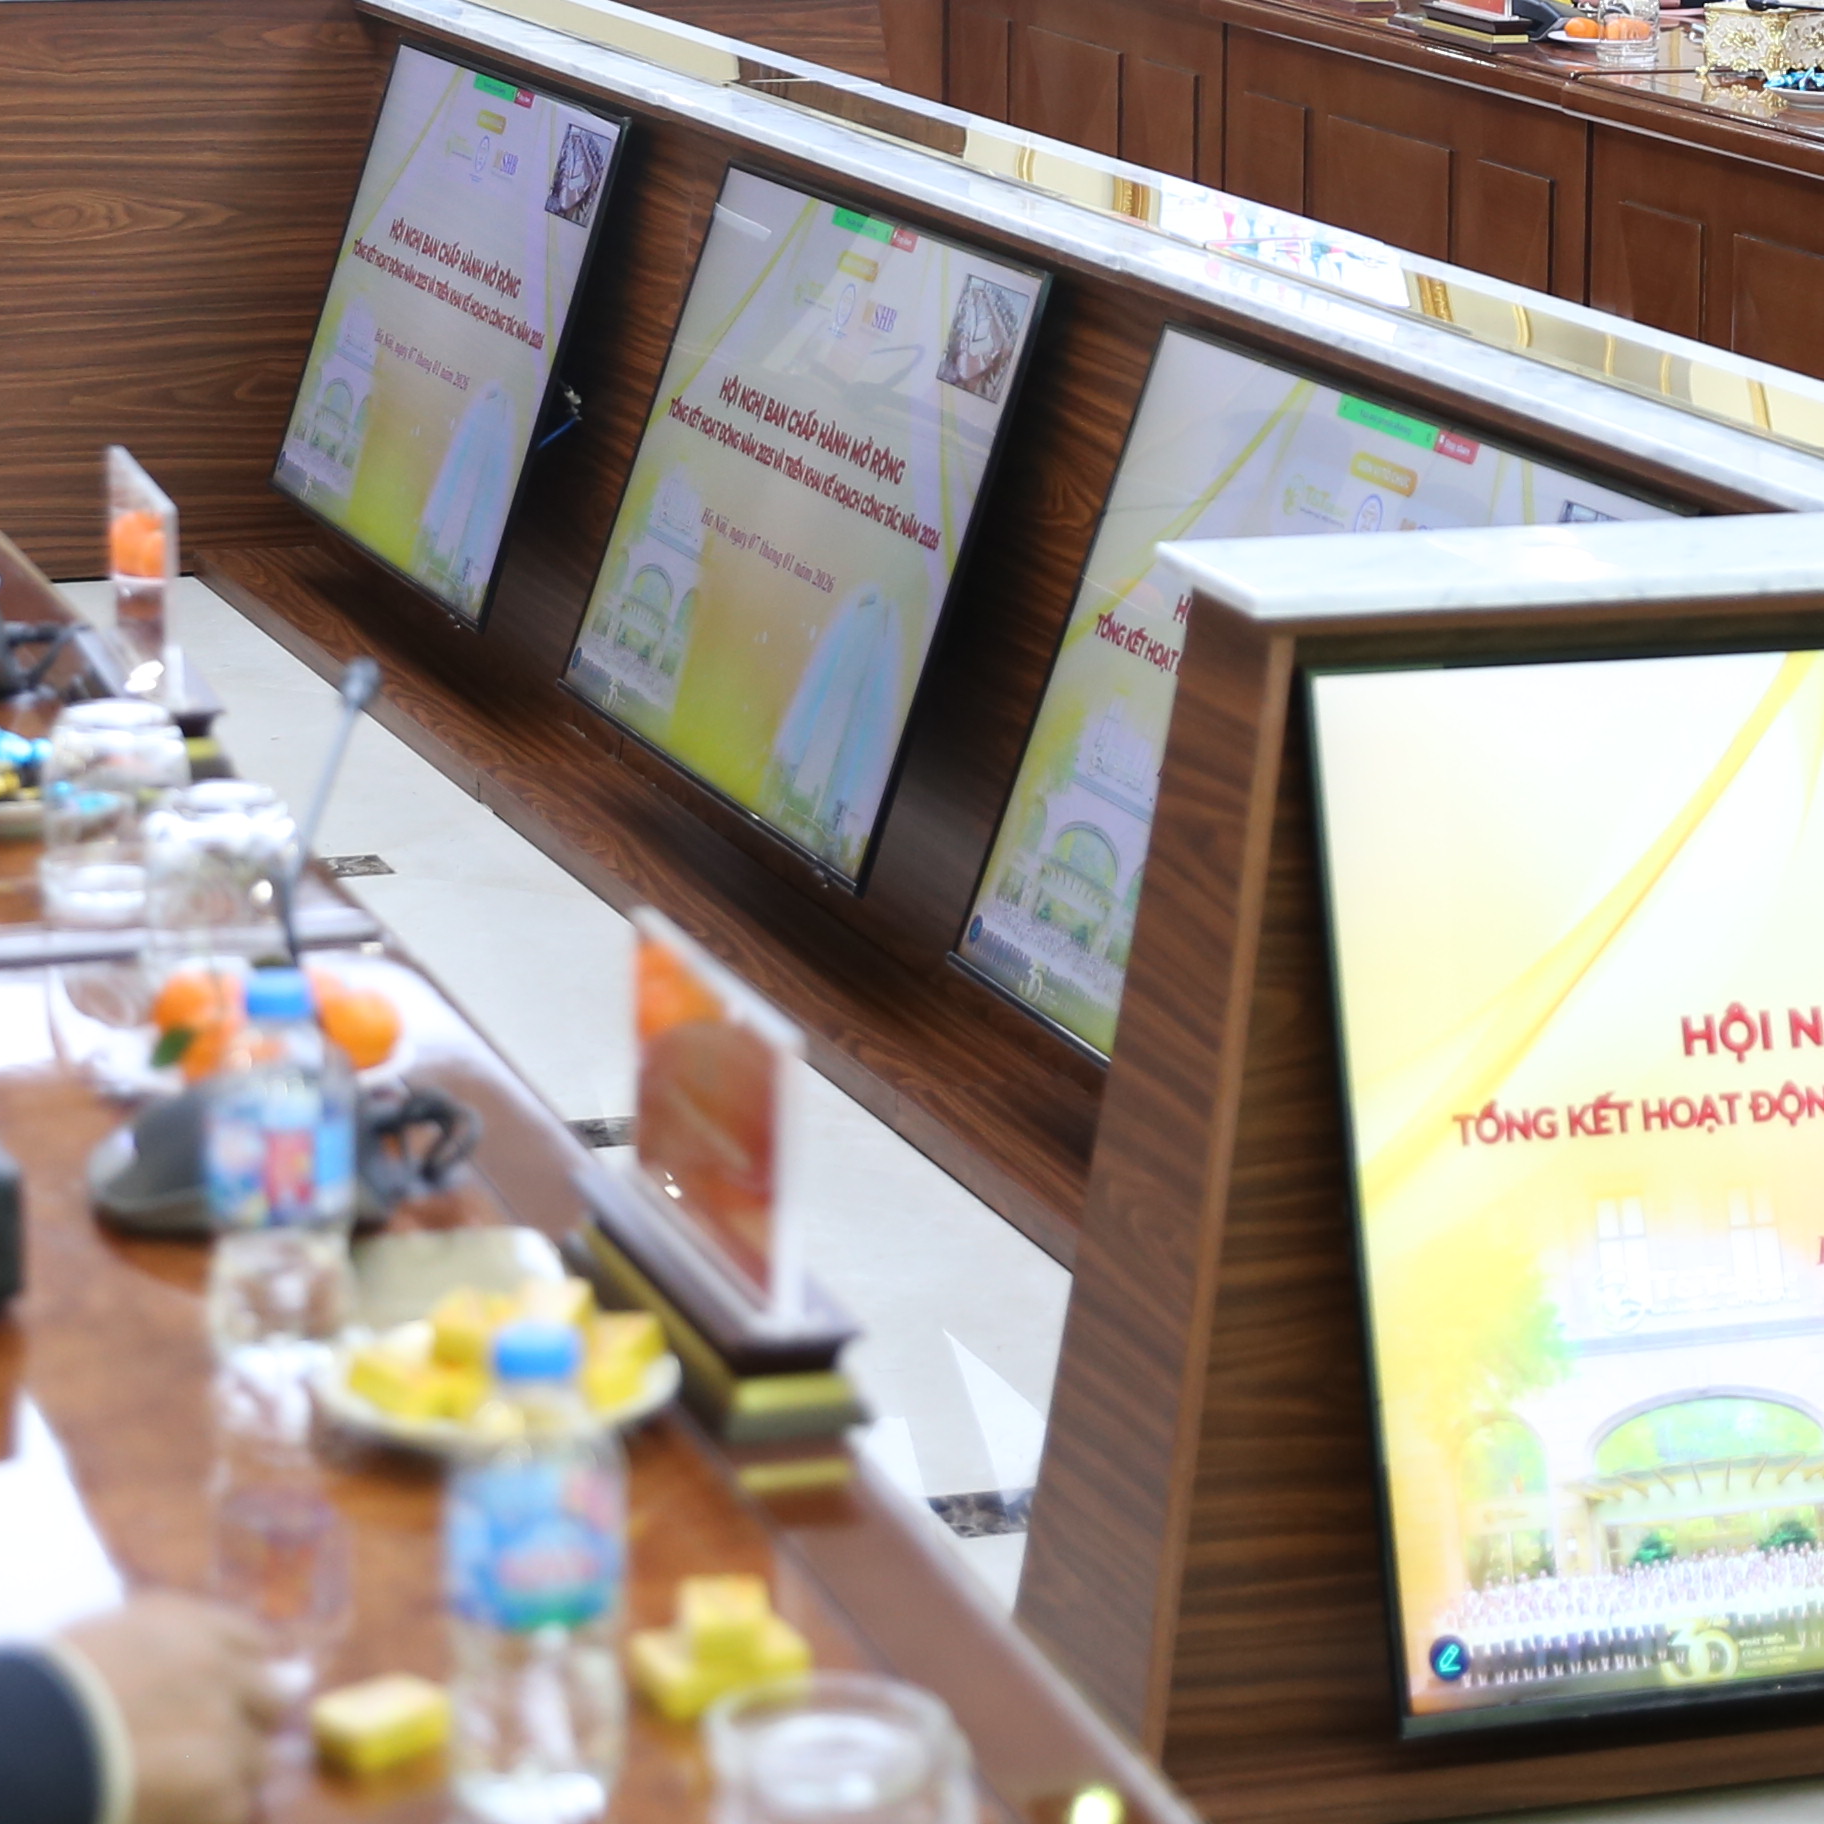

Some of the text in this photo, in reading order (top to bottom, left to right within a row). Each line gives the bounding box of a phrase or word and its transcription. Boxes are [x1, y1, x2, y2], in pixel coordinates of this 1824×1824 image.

[719, 375, 905, 484] HỘI NGHỊ BAN CHẤP HÀNH MỞ RỘNG
[1095, 611, 1127, 647] TỔNG
[1126, 627, 1149, 657] KẾT
[1680, 1002, 1772, 1058] HỘI
[1451, 1101, 1558, 1145] TỔNG
[1566, 1092, 1632, 1137] KẾT
[1640, 1092, 1741, 1133] HOẠT
